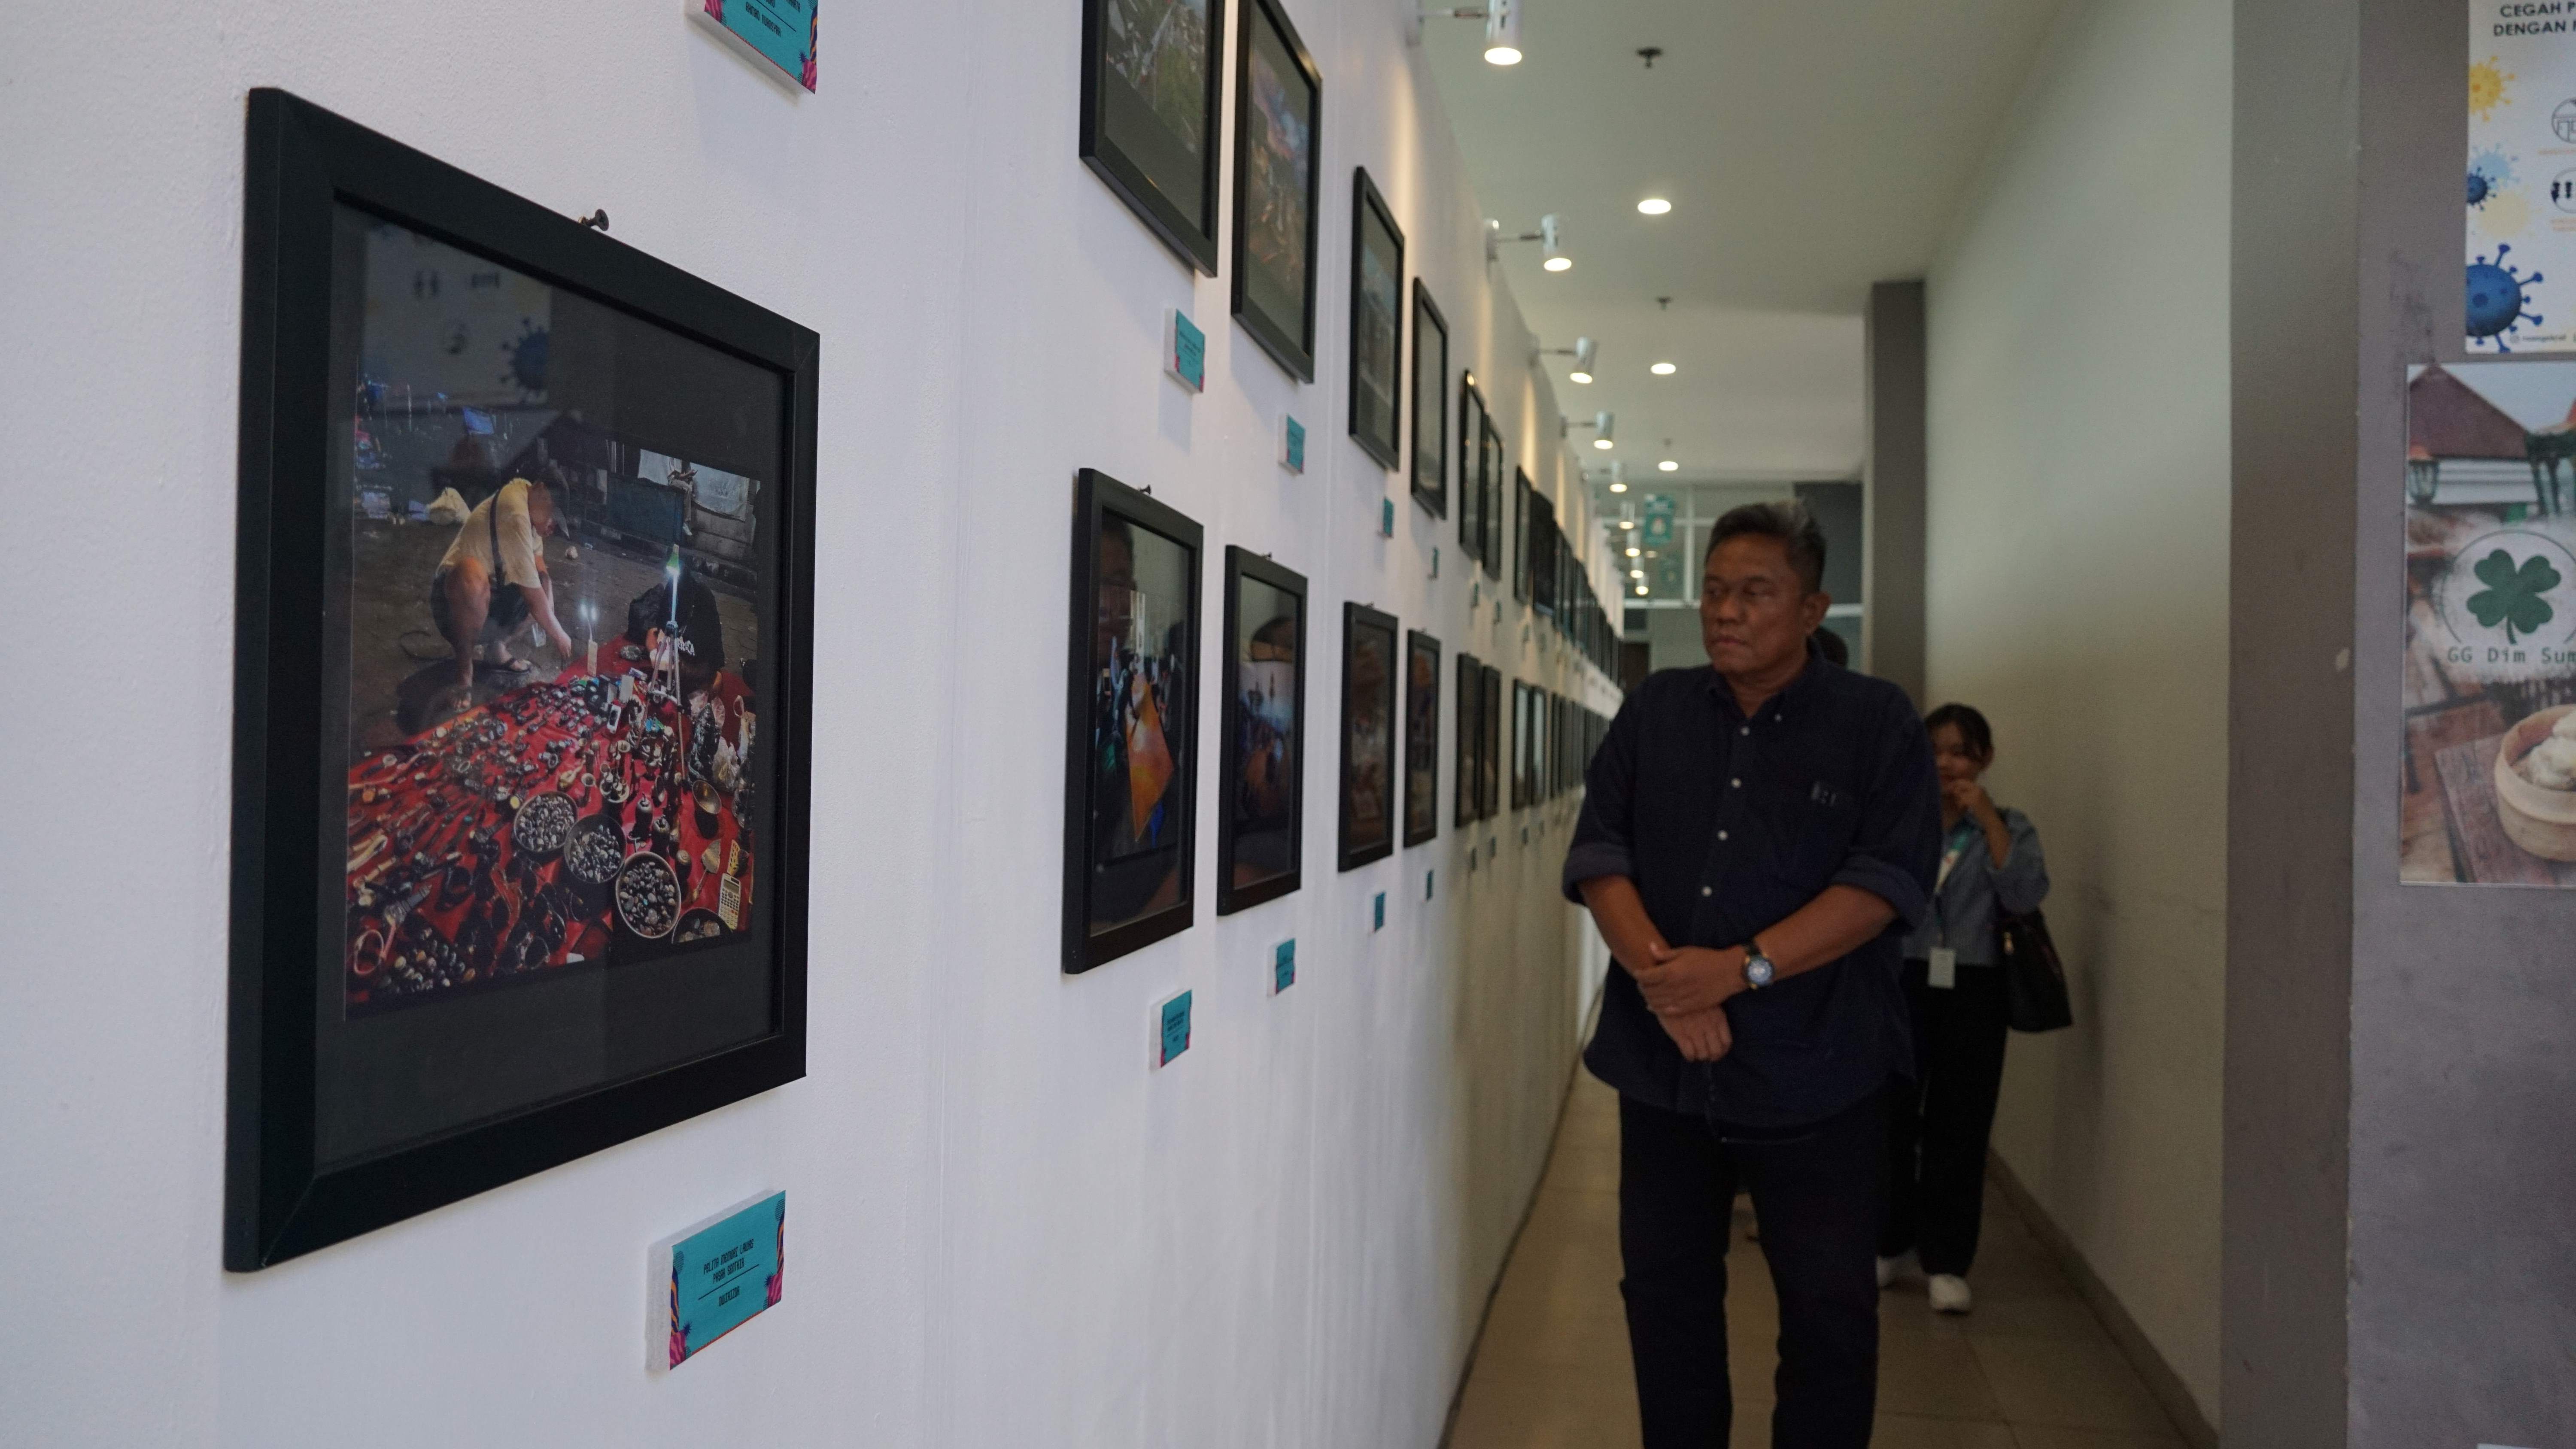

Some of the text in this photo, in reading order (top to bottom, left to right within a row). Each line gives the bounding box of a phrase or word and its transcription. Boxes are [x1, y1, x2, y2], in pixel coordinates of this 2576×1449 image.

[2500, 2, 2561, 18] CEGAH
[2493, 20, 2566, 36] DENGAN
[2447, 646, 2473, 663] GG
[2487, 646, 2526, 663] Dim
[704, 1239, 754, 1275] PELITA MEMORI LAWAS
[713, 1268, 726, 1284] PASAR
